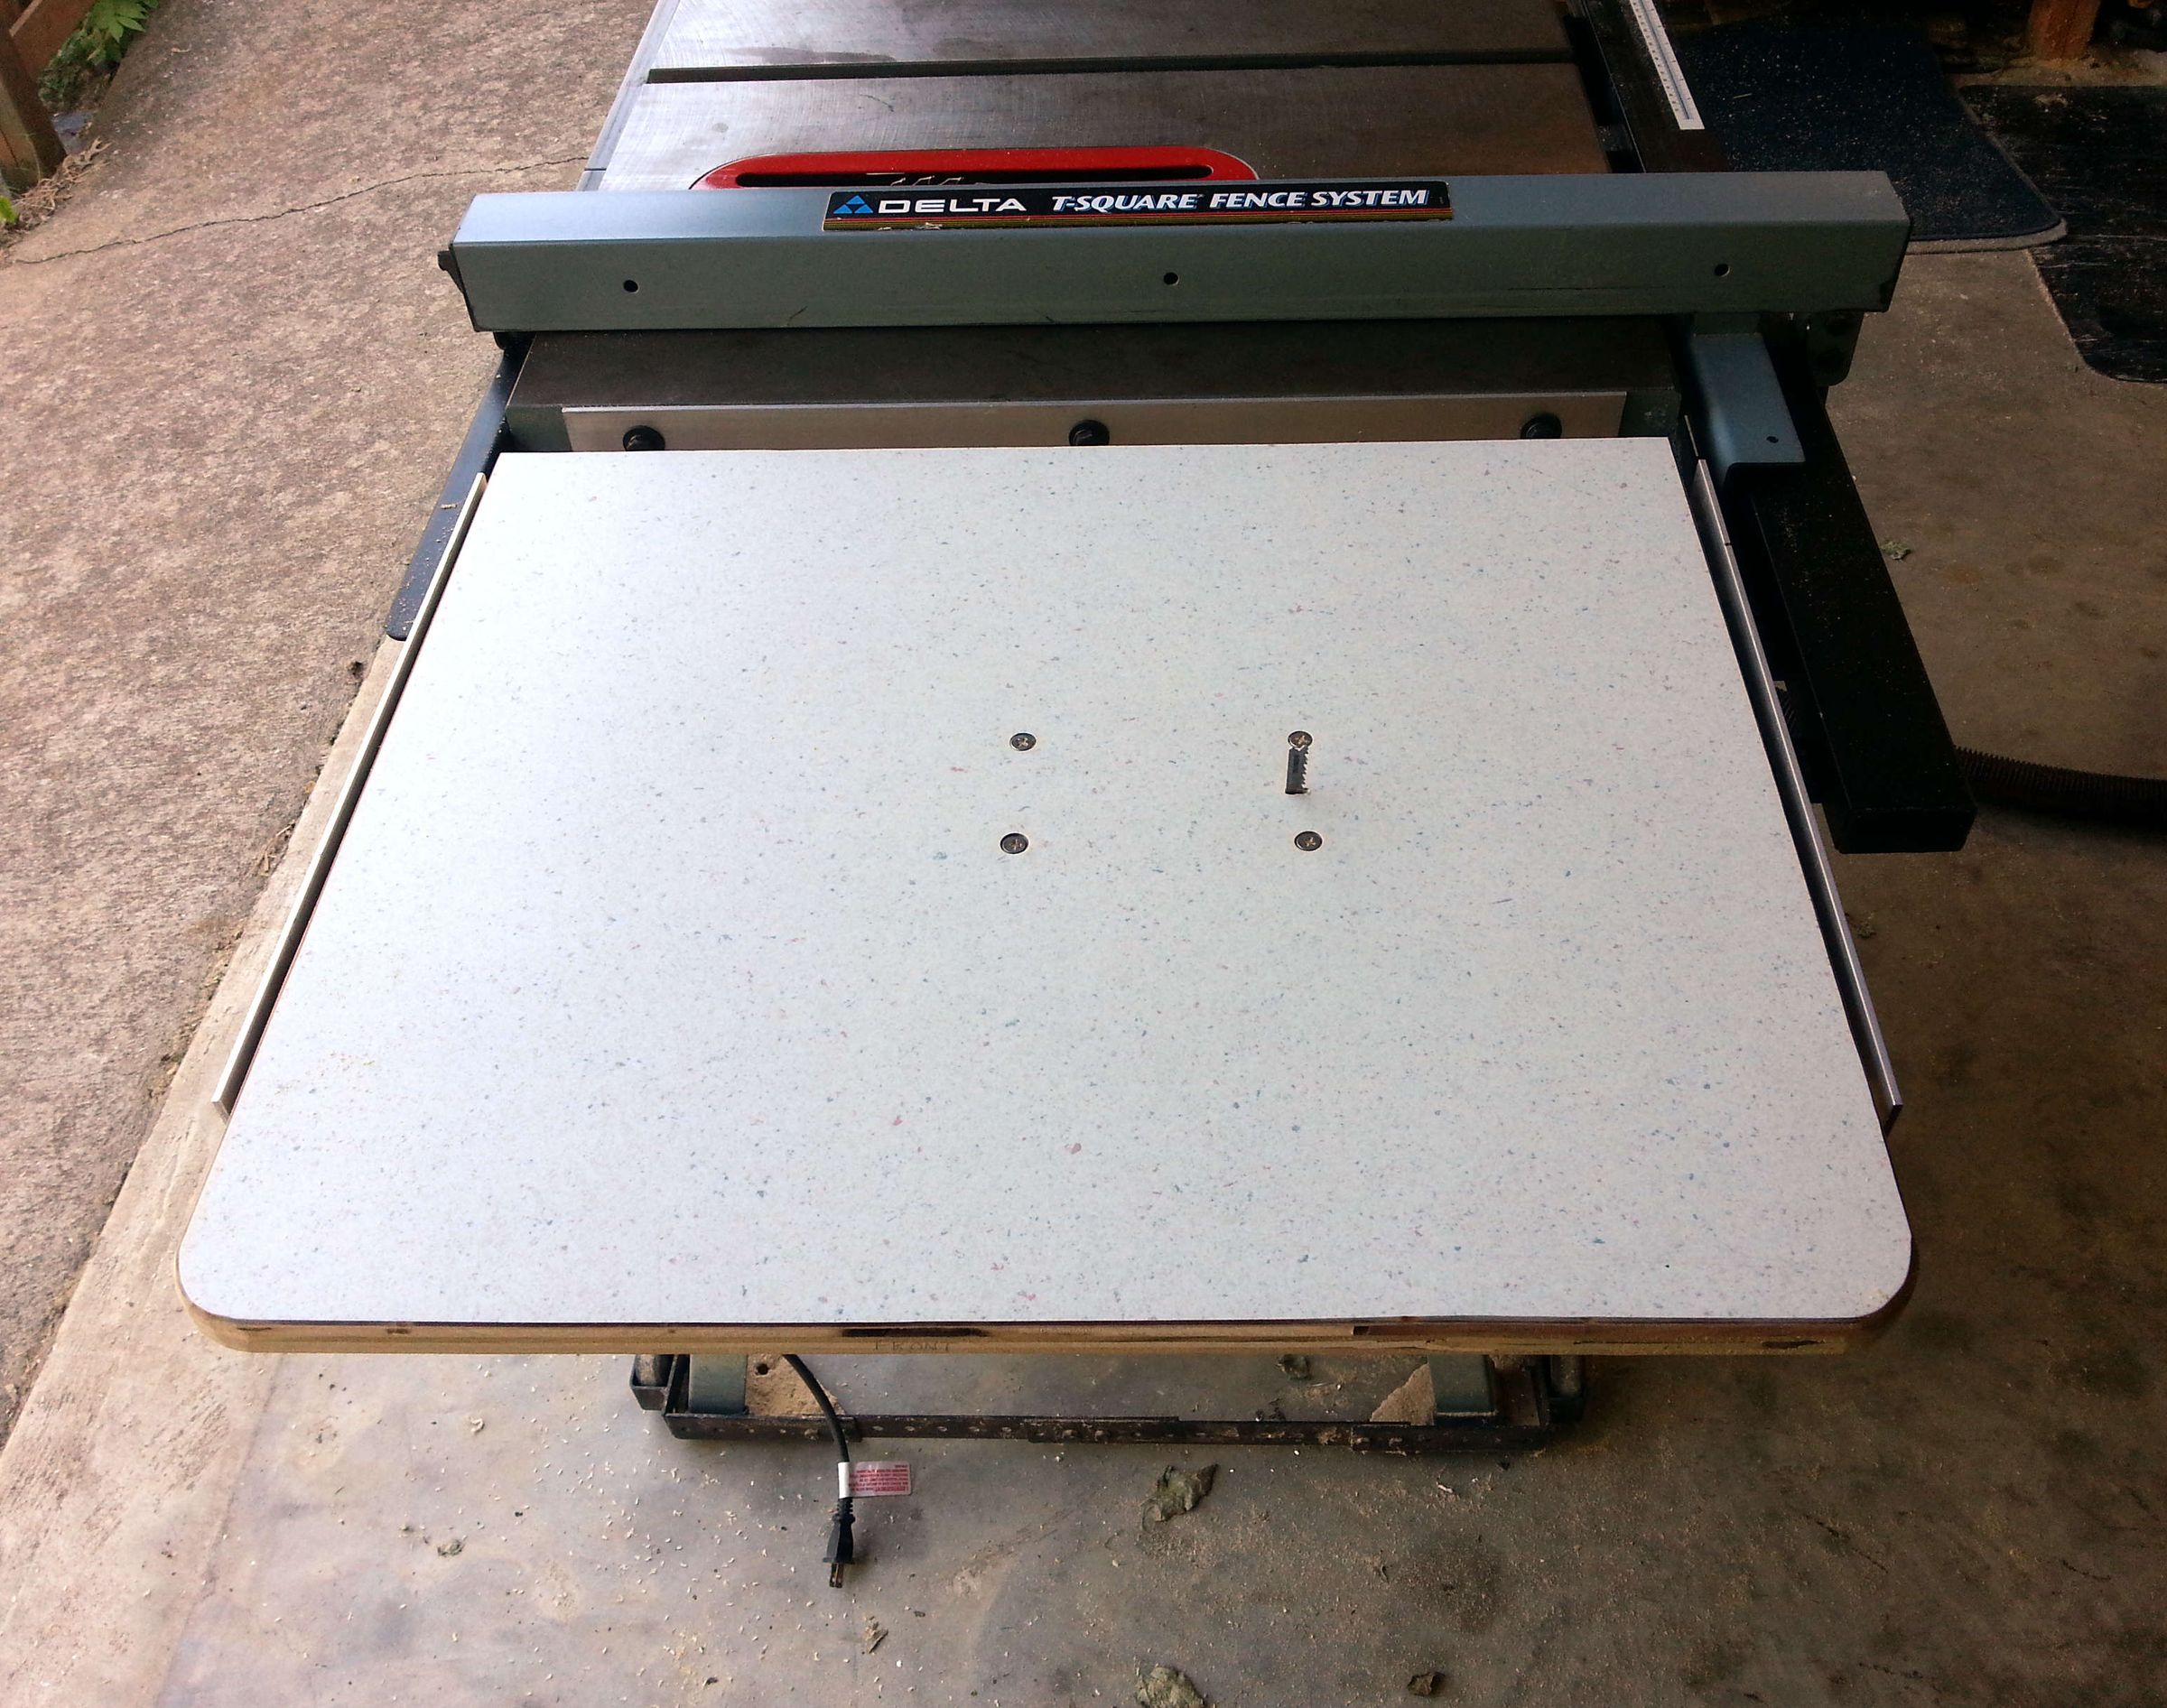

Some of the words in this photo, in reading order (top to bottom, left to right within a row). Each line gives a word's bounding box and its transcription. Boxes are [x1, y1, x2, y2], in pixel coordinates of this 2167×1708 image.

[878, 198, 1027, 214] DELTA
[1052, 193, 1197, 213] T-SQUARE
[1209, 191, 1307, 209] FENCE
[1310, 189, 1429, 207] SYSTEM
